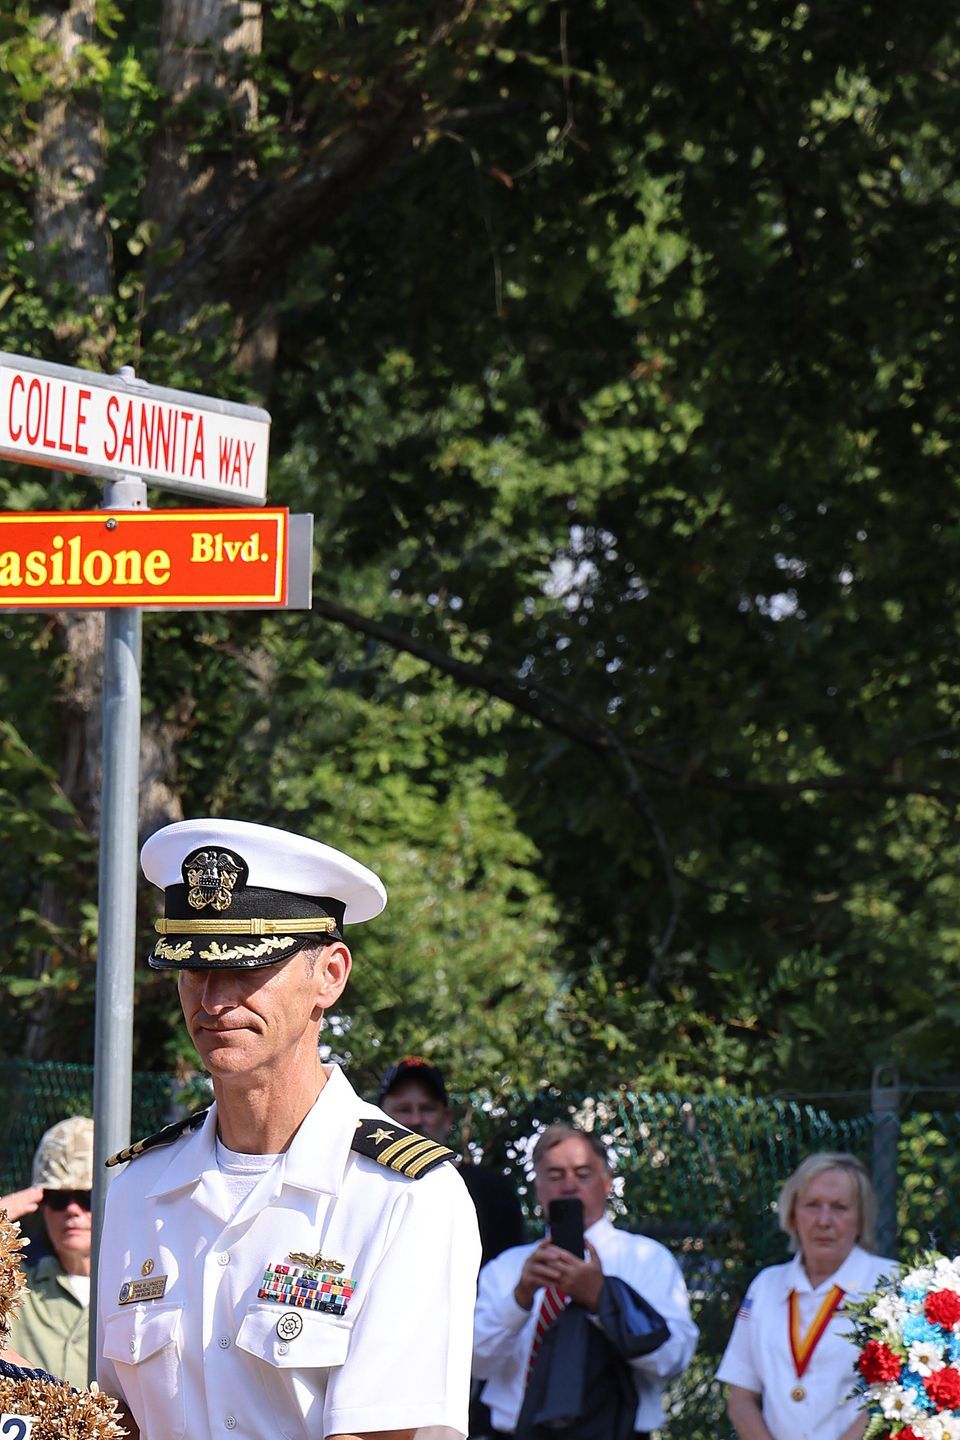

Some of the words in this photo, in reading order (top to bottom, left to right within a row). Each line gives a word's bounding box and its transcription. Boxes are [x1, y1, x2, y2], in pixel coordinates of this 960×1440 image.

[8, 374, 92, 456] COLLE
[103, 395, 206, 480] SANNITA
[218, 434, 256, 489] WAY
[190, 532, 269, 563] Blvd.
